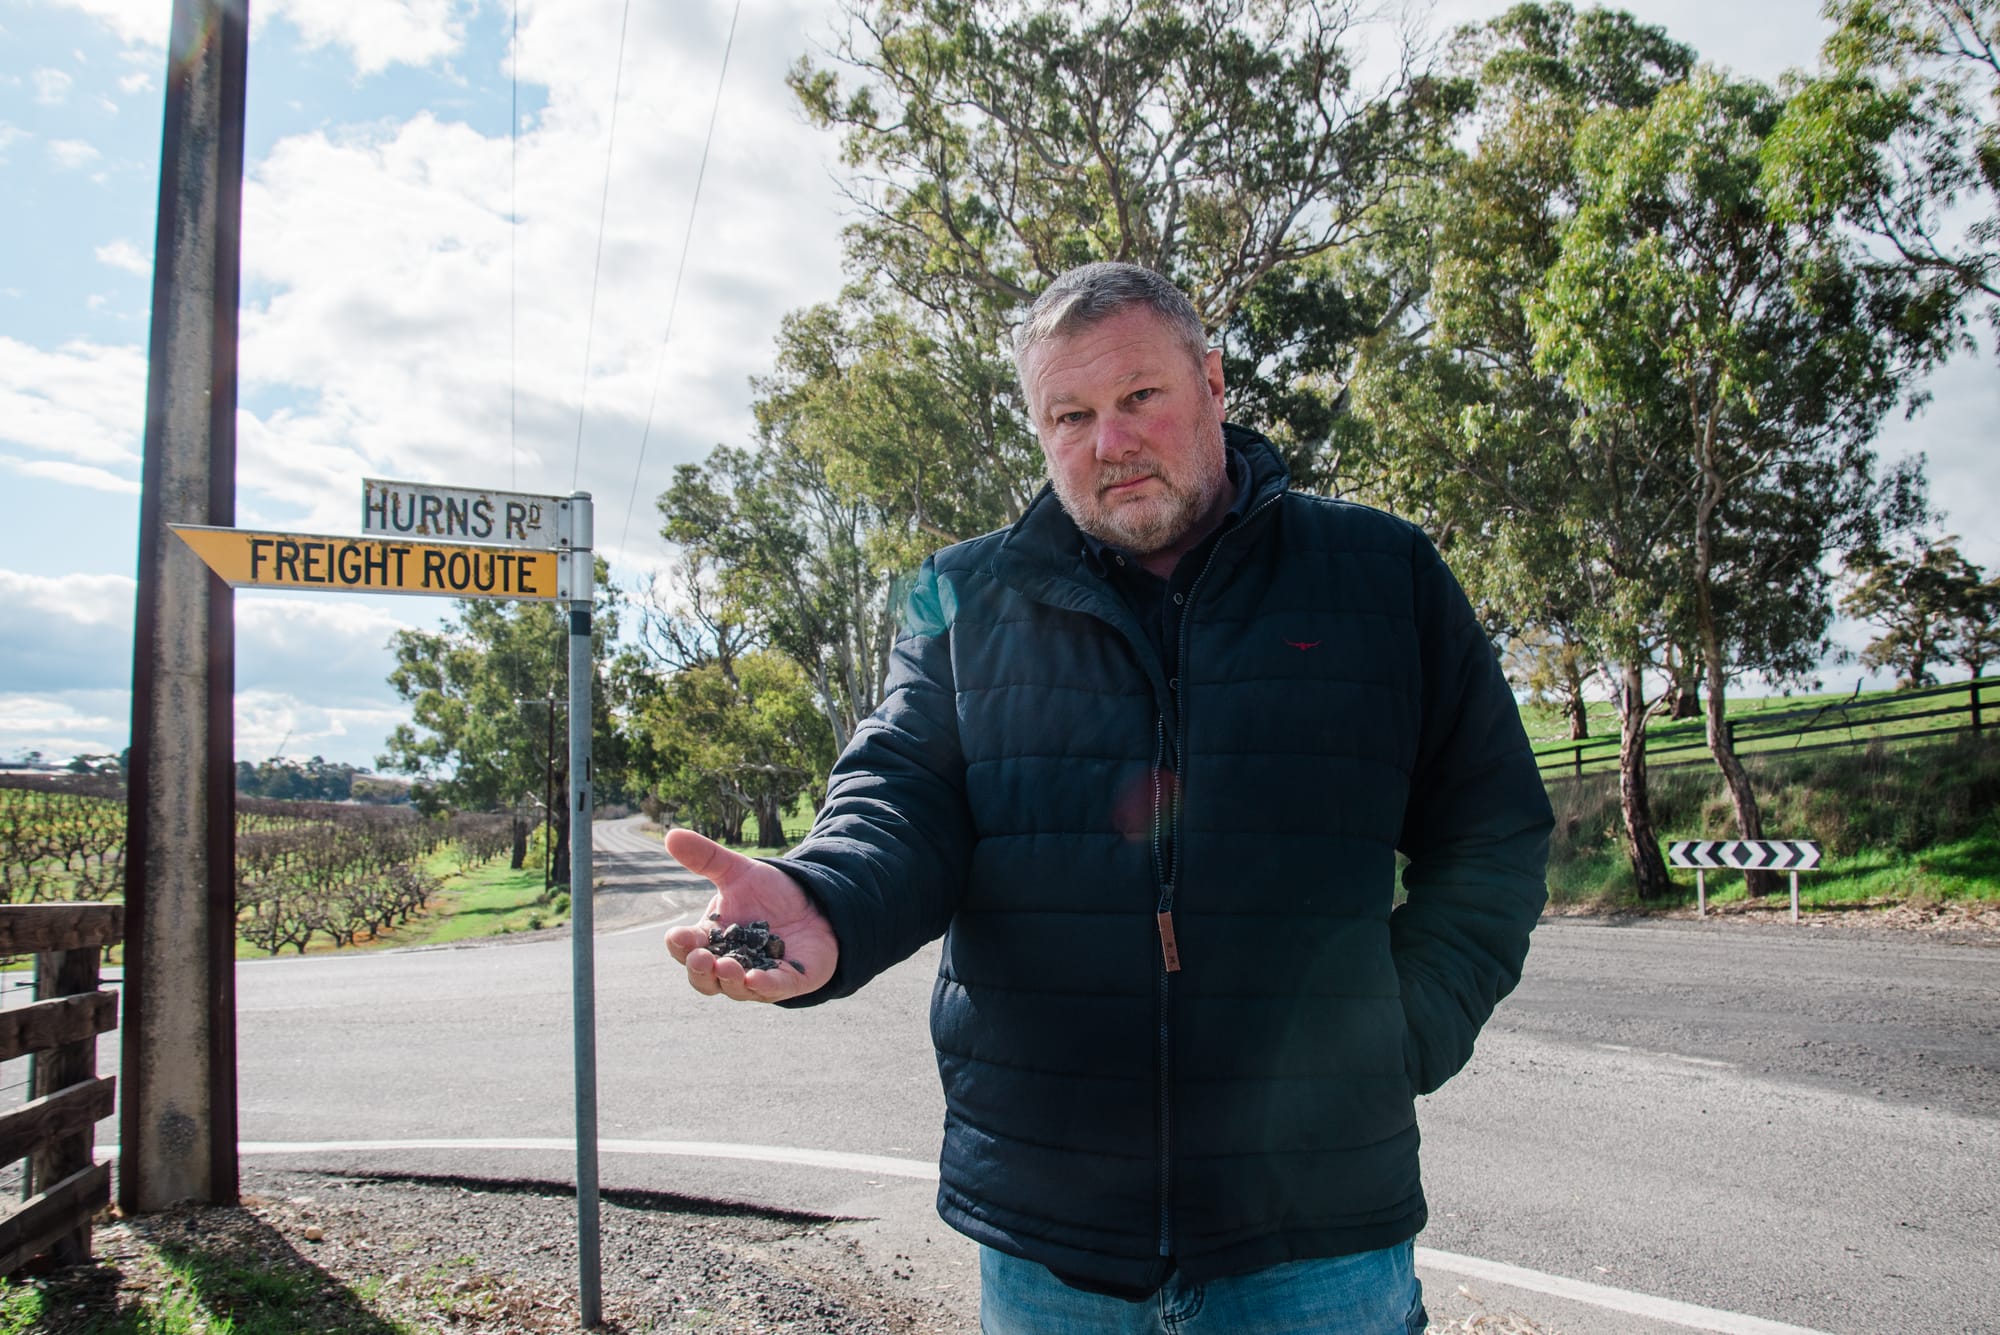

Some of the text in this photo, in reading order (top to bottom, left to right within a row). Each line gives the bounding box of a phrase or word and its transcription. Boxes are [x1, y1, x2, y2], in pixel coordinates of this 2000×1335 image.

[365, 486, 493, 538] HURNS
[251, 539, 537, 593] FREIGHT ROUTE
